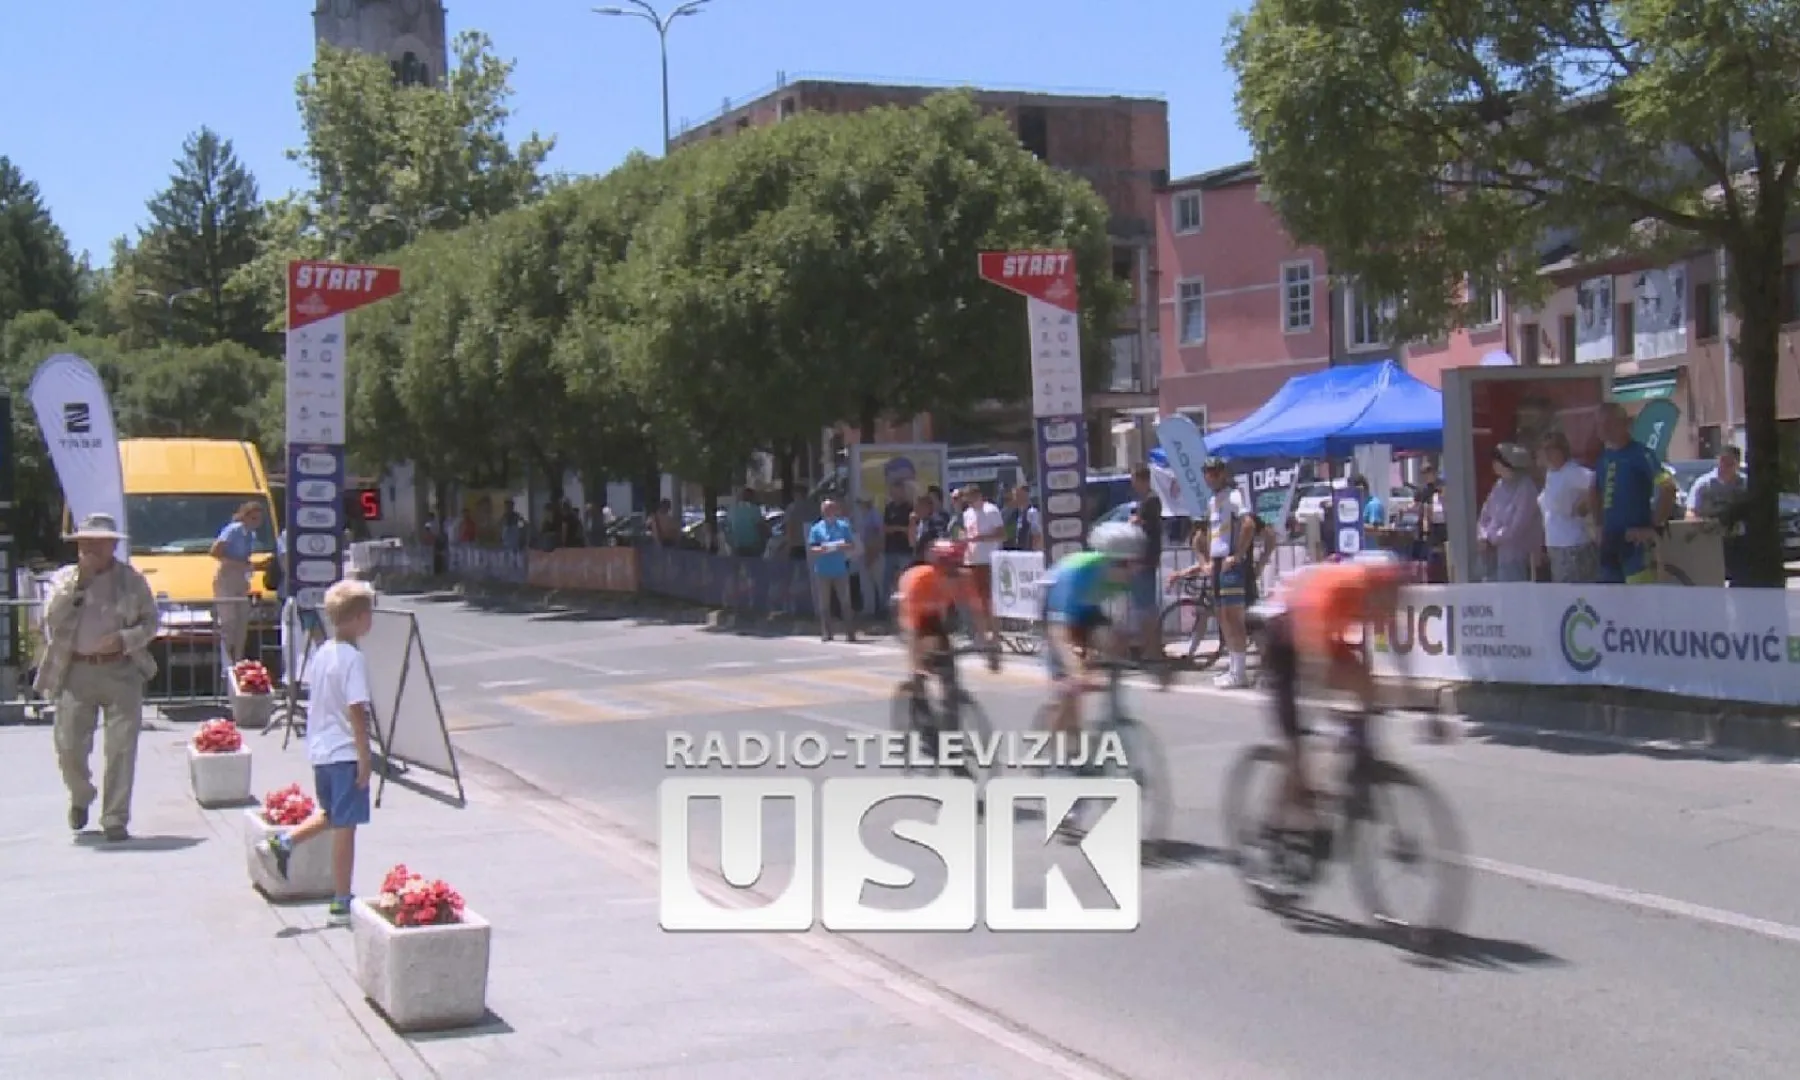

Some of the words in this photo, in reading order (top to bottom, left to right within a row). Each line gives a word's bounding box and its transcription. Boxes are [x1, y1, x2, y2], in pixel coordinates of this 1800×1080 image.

[296, 265, 379, 292] START
[1003, 255, 1069, 278] START
[360, 491, 377, 517] 5
[1462, 605, 1494, 618] UNION
[1389, 605, 1455, 656] UCI
[1603, 620, 1781, 663] ČAVKUNOVIĆ
